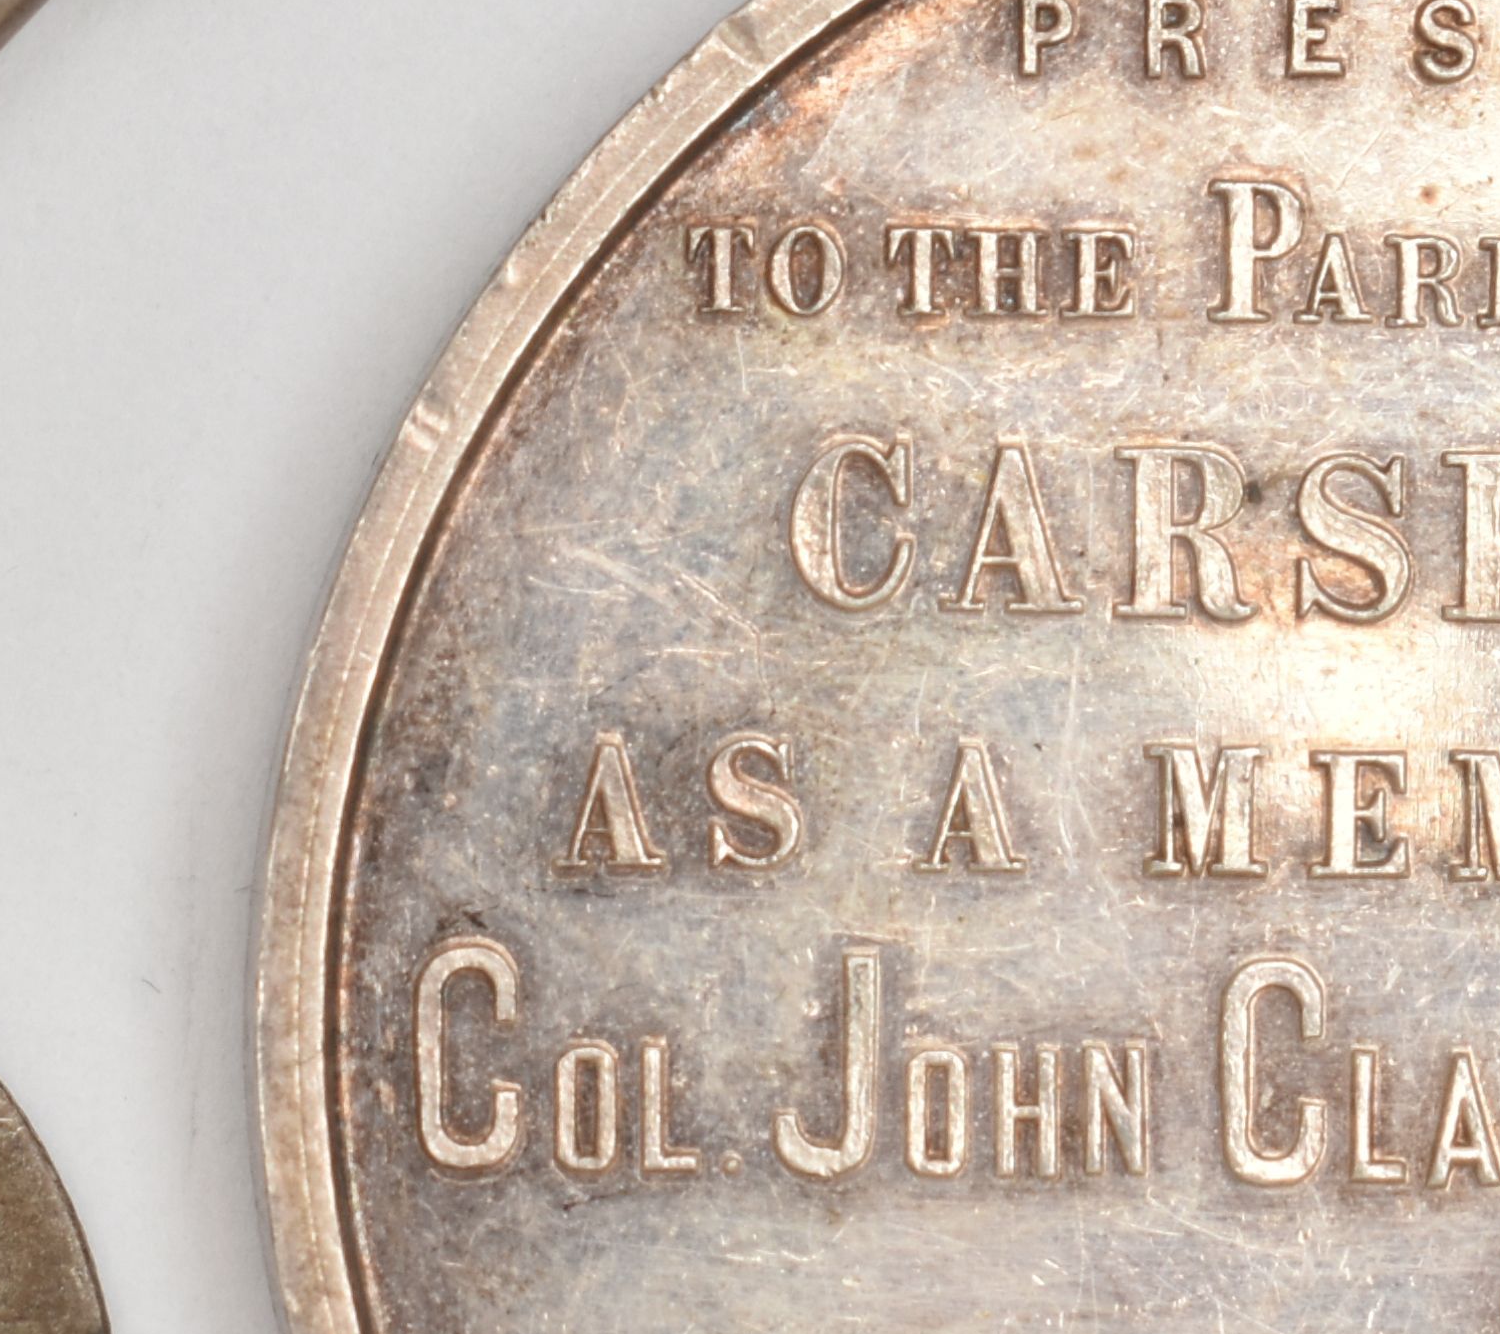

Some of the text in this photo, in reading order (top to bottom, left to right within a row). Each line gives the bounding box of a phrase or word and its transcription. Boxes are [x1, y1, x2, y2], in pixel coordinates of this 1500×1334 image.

[688, 224, 847, 317] TO
[886, 226, 1137, 321] THE
[556, 733, 803, 870] AS
[917, 736, 1026, 870] A
[774, 935, 1148, 1178] JOHN
